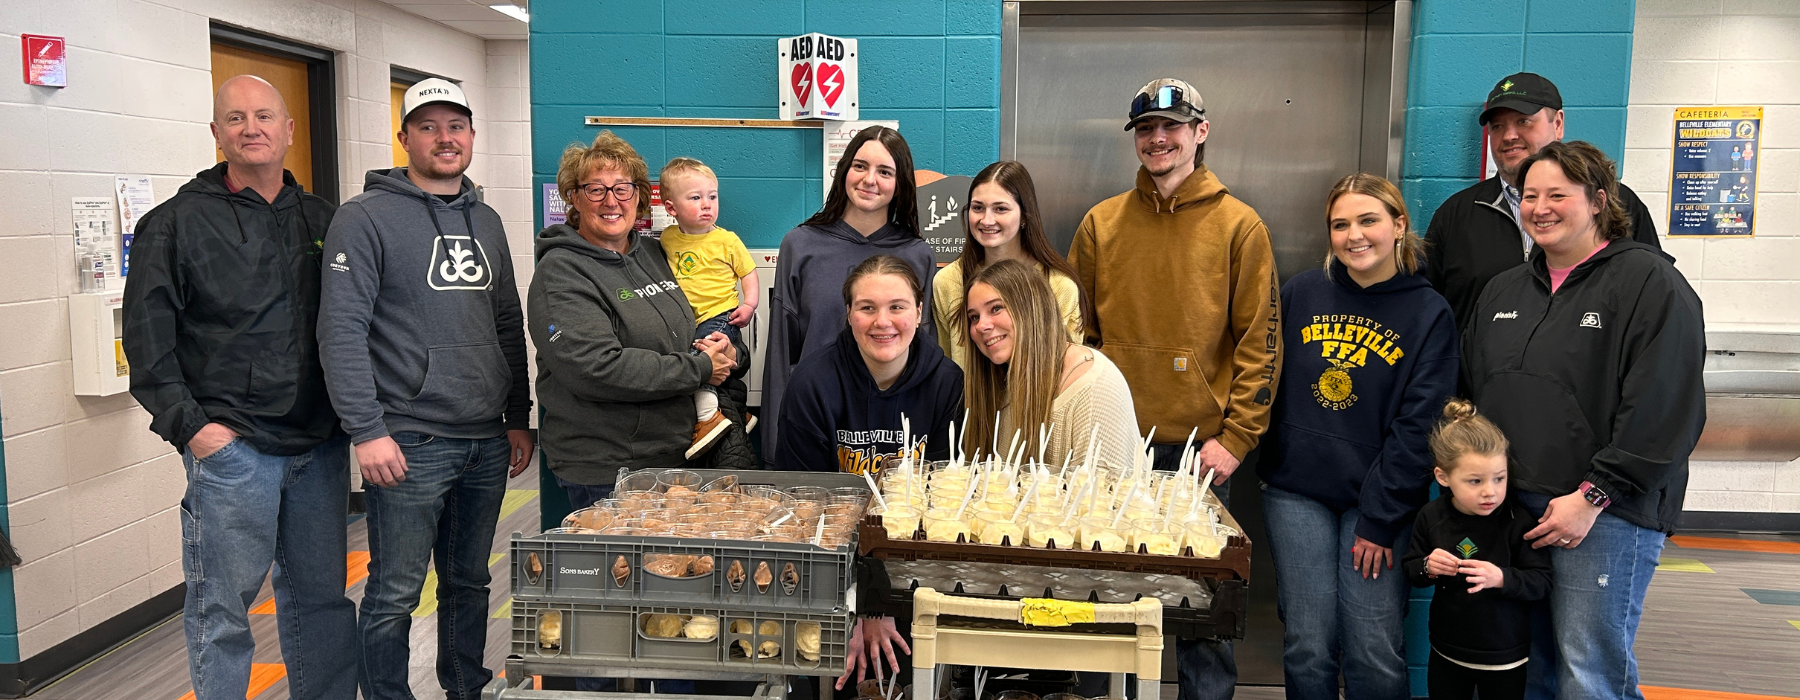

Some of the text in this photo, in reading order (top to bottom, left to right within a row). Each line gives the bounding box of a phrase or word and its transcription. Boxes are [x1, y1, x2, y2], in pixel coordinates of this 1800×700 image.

[790, 36, 813, 61] AED
[816, 36, 844, 61] AED
[419, 88, 442, 97] NEXTA
[1680, 128, 1731, 138] WILDCATS
[1313, 315, 1400, 341] PROPERTY OF
[1301, 324, 1404, 366] BELLEVILLE
[1322, 341, 1368, 367] FFA
[1311, 384, 1358, 410] 2022-2023
